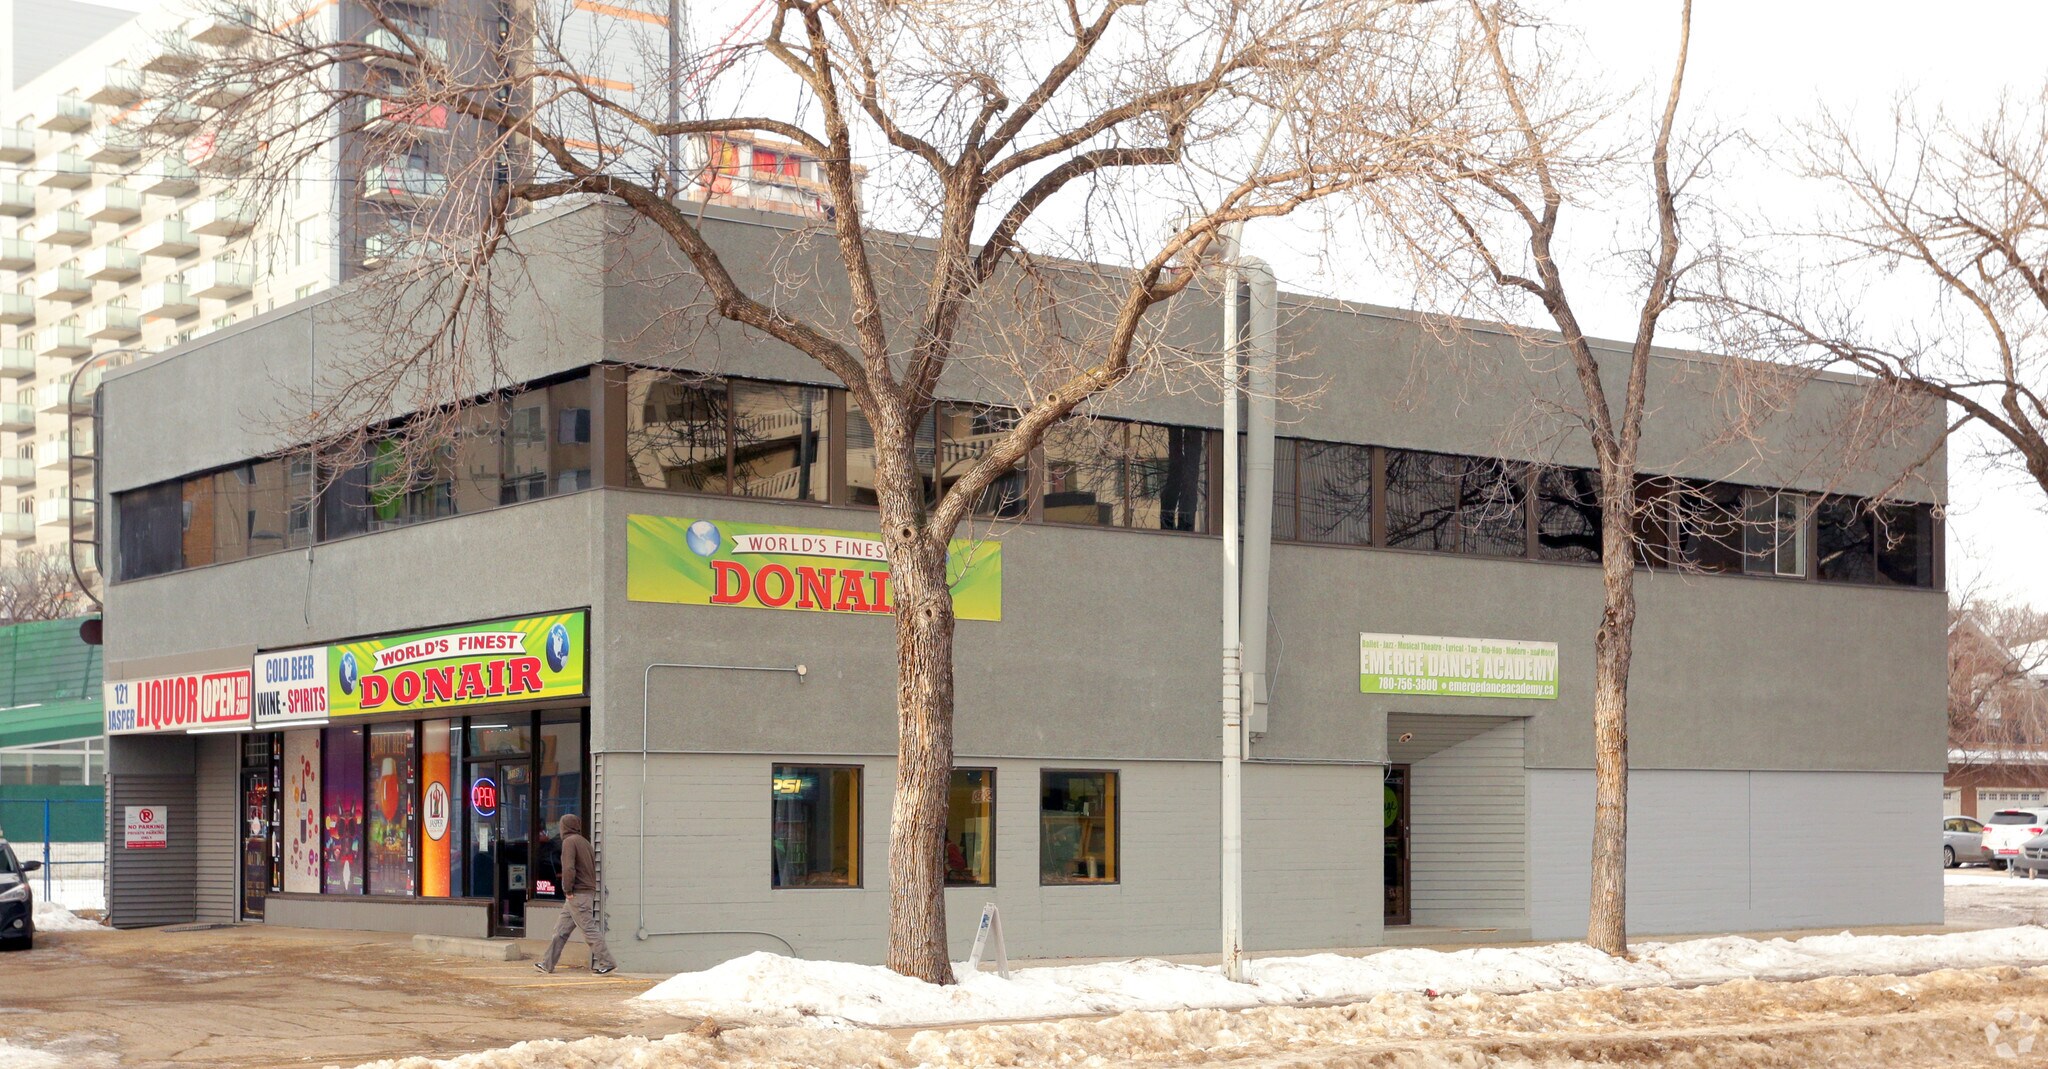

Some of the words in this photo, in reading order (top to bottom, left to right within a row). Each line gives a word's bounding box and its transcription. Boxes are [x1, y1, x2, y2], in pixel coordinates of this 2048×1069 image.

[749, 536, 827, 553] WORLD'S
[835, 540, 885, 559] FINES
[710, 560, 896, 614] DONAI
[381, 639, 449, 667] WORLD'S
[458, 634, 518, 651] FINEST
[1383, 641, 1394, 649] Jazz
[1397, 641, 1420, 650] Musical
[1420, 642, 1442, 651] Theatre
[1445, 644, 1464, 653] Lyrical
[266, 658, 289, 684] COLD
[291, 654, 314, 680] BEER
[1361, 651, 1424, 676] EMERGE
[1428, 653, 1480, 679] DANCE
[1482, 656, 1556, 682] ACADEMY
[114, 683, 128, 704] 121
[360, 656, 544, 708] DONAIR
[1379, 676, 1438, 692] 780-756-3800
[1448, 680, 1554, 696] emergedanceacademy.ca
[136, 676, 199, 731] LIQUOR
[203, 676, 236, 719] OPEN
[257, 690, 281, 716] WINE
[287, 686, 326, 714] SPIRITS
[108, 708, 135, 732] JASPER
[472, 785, 496, 808] OPEN
[773, 778, 802, 794] PSI
